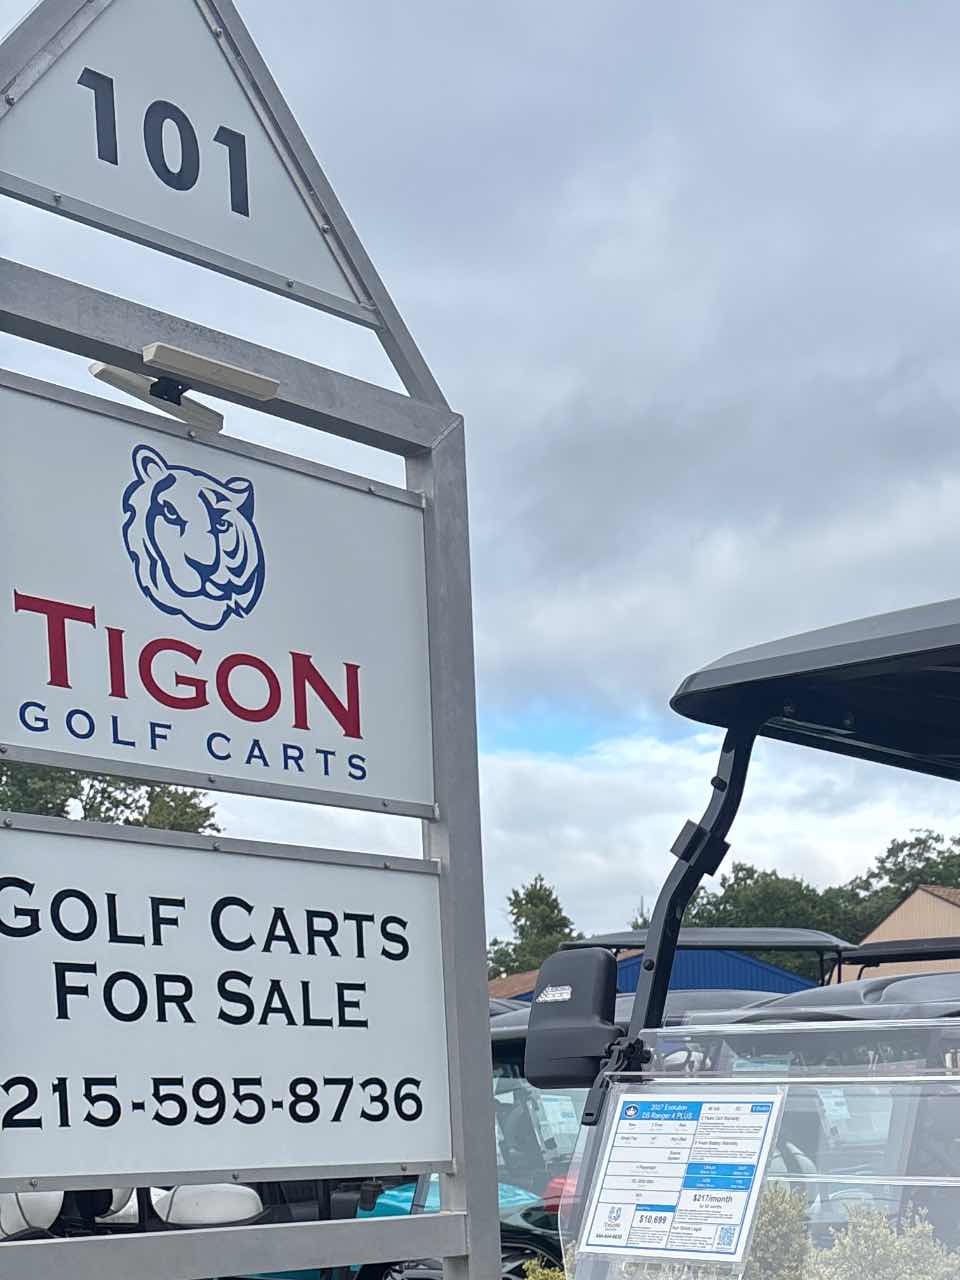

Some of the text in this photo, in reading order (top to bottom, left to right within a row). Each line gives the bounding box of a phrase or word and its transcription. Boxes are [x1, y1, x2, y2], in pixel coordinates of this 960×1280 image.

[77, 66, 250, 218] 101
[14, 590, 362, 739] TIGON
[18, 701, 368, 782] GOLF CARTS
[0, 876, 410, 961] GOLF CARTS
[52, 961, 369, 1029] FOR SALE
[0, 1076, 423, 1130] 215-595-8736
